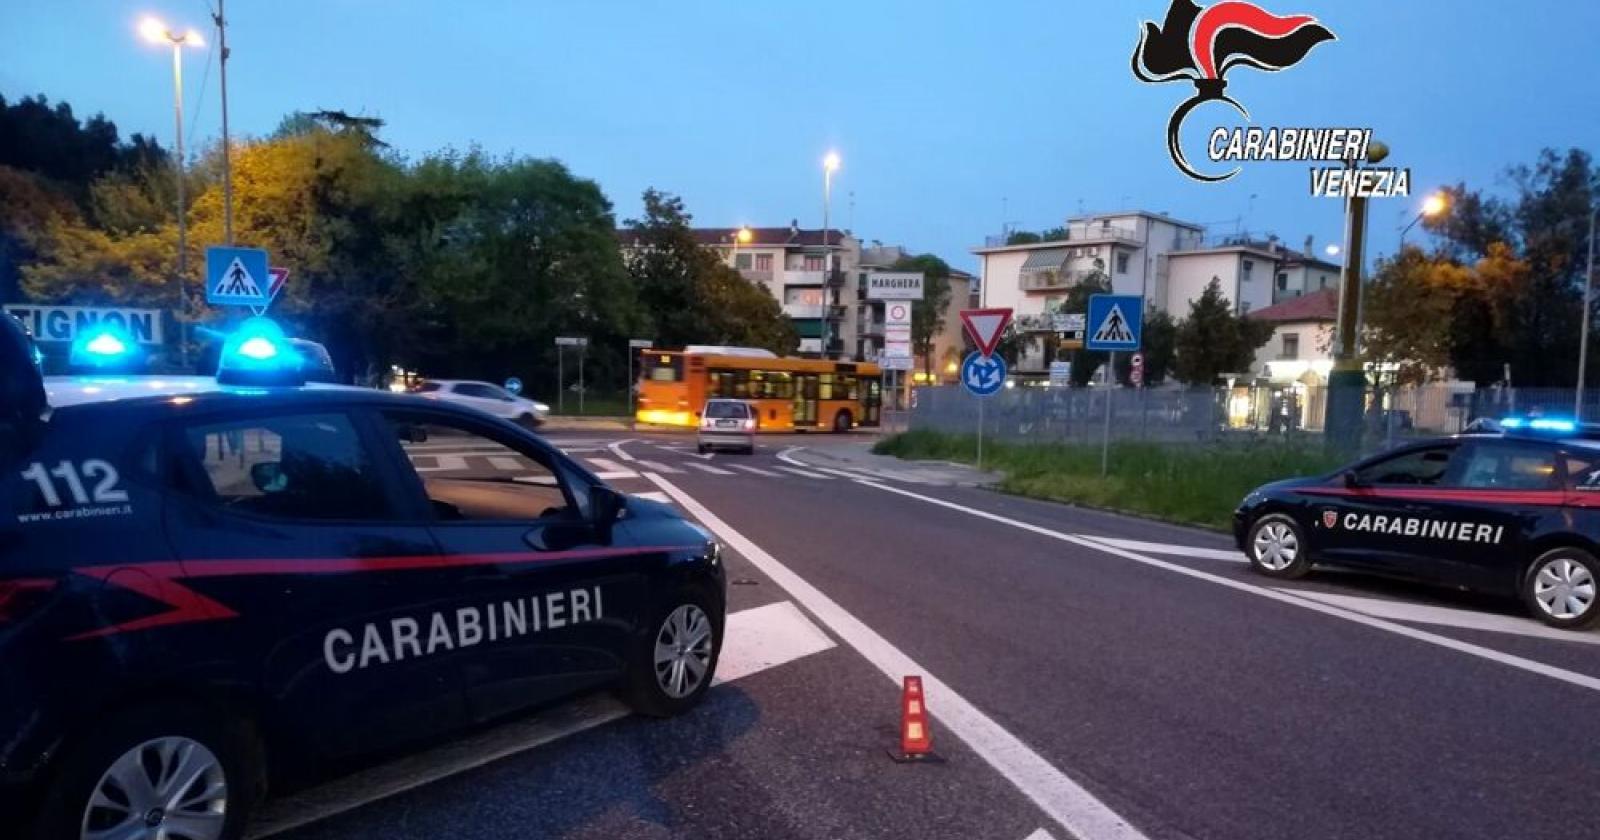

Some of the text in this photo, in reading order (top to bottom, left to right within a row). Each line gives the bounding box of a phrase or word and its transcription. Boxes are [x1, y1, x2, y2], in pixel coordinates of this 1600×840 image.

[871, 278, 921, 289] MARGHERA
[20, 459, 129, 506] 112
[1343, 513, 1504, 544] CARABINIERI
[323, 586, 603, 673] CARABINIERI
